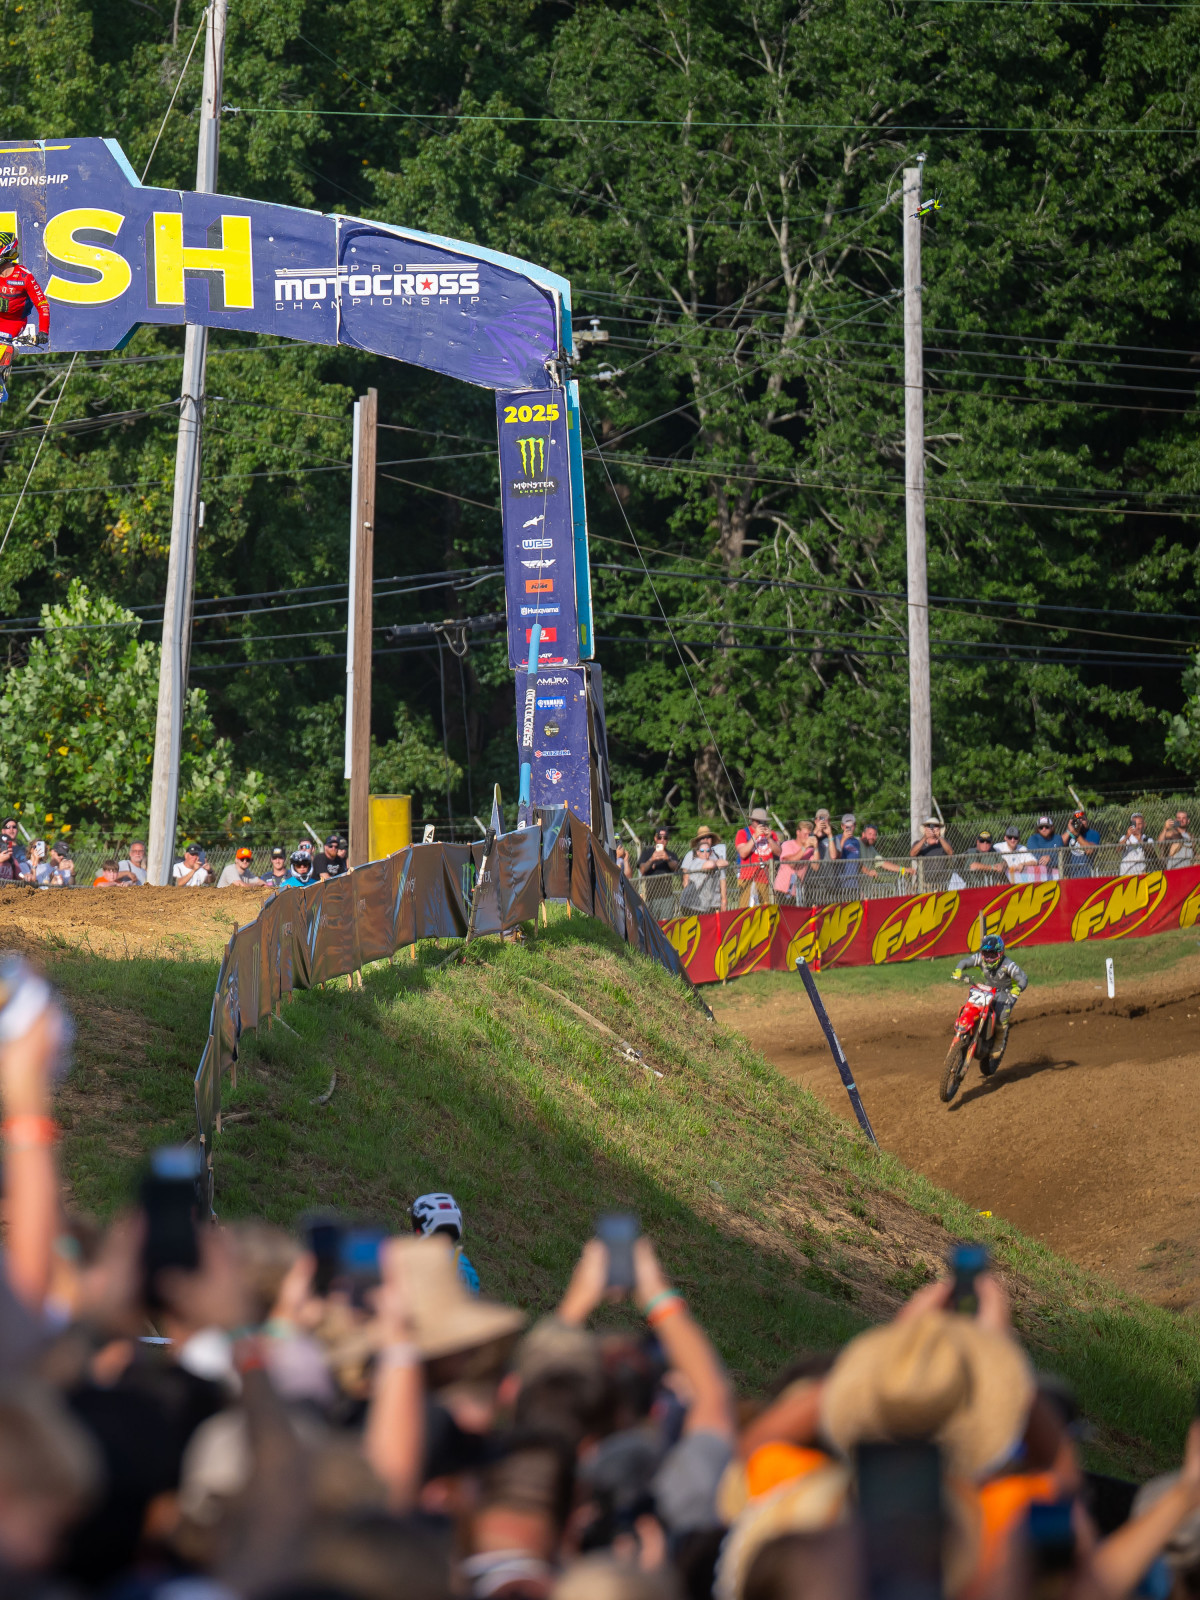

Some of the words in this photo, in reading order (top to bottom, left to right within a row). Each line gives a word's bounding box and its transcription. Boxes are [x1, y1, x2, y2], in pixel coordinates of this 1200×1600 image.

[350, 263, 403, 273] PRO
[274, 273, 480, 301] MOTOCROSS
[275, 296, 480, 311] CHAMPIONSHIP
[503, 403, 560, 424] 2025
[513, 480, 555, 491] MONSTER
[523, 539, 552, 549] WPS
[1073, 870, 1164, 942] FMF
[874, 890, 958, 965] FMF
